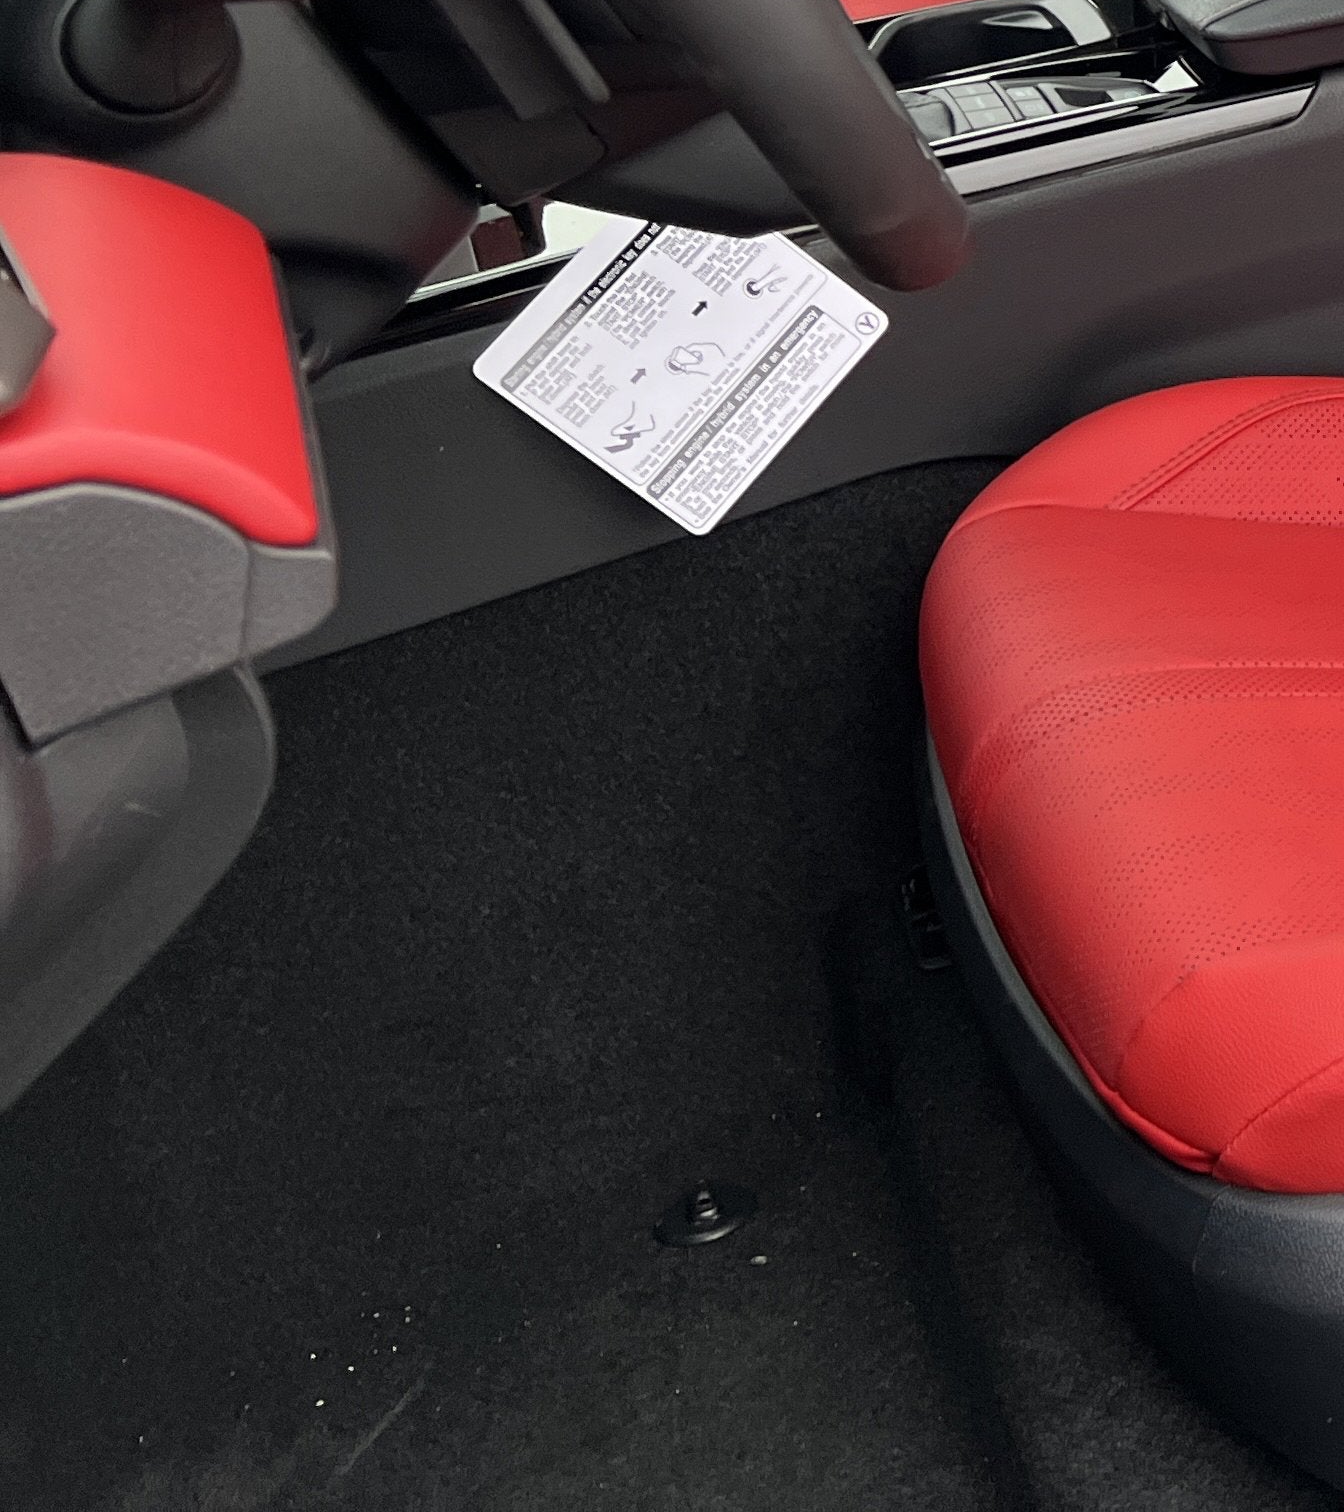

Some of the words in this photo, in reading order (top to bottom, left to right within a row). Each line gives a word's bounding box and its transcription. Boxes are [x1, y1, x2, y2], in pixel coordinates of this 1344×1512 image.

[585, 284, 602, 299] the
[595, 257, 628, 289] electronic
[620, 246, 639, 262] key
[631, 231, 652, 250] does
[649, 456, 688, 496] Stopping
[681, 428, 712, 460] engine
[707, 399, 738, 429] hybrid
[731, 371, 764, 403] system
[757, 361, 771, 373] in
[766, 349, 783, 364] an
[778, 308, 821, 352] emergency
